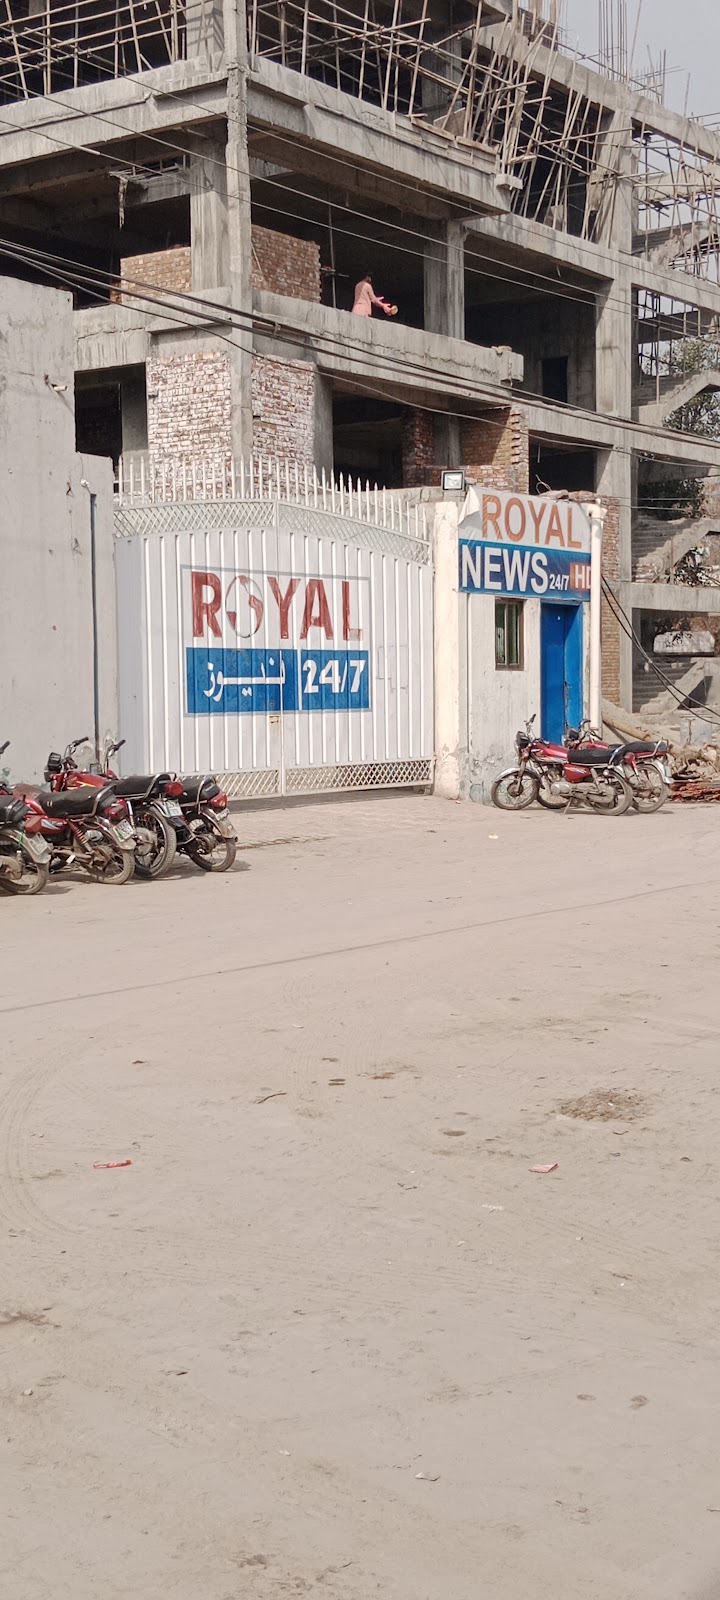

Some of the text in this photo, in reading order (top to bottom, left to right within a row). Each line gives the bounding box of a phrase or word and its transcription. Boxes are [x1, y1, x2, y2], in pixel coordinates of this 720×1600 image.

[481, 493, 582, 549] ROYAL
[461, 544, 549, 594] NEWS
[549, 573, 570, 591] 24/7
[191, 571, 363, 641] ROYAL
[302, 659, 366, 694] 24/7
